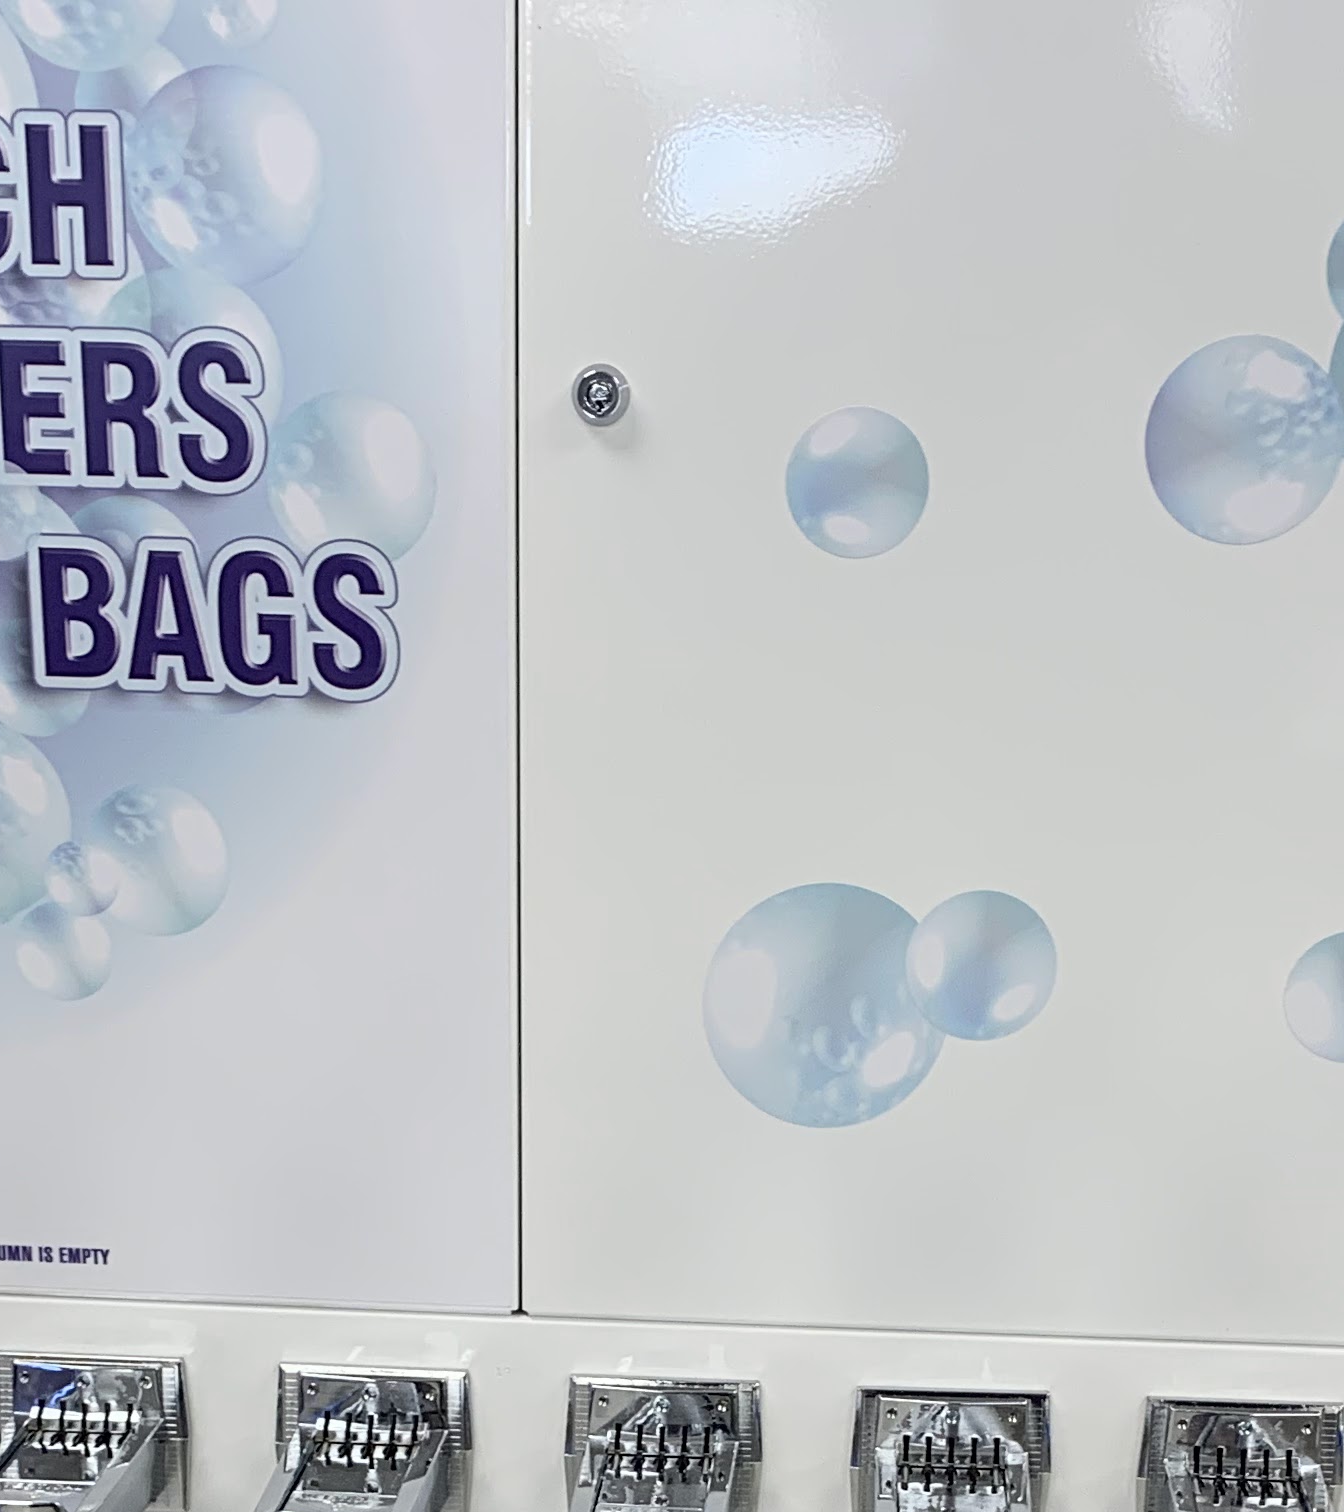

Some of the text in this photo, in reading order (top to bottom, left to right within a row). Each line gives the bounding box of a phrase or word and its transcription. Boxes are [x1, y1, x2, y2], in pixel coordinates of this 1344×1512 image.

[36, 545, 394, 693] BAGS
[39, 1246, 53, 1264] IS
[59, 1246, 110, 1266] EMPTY
